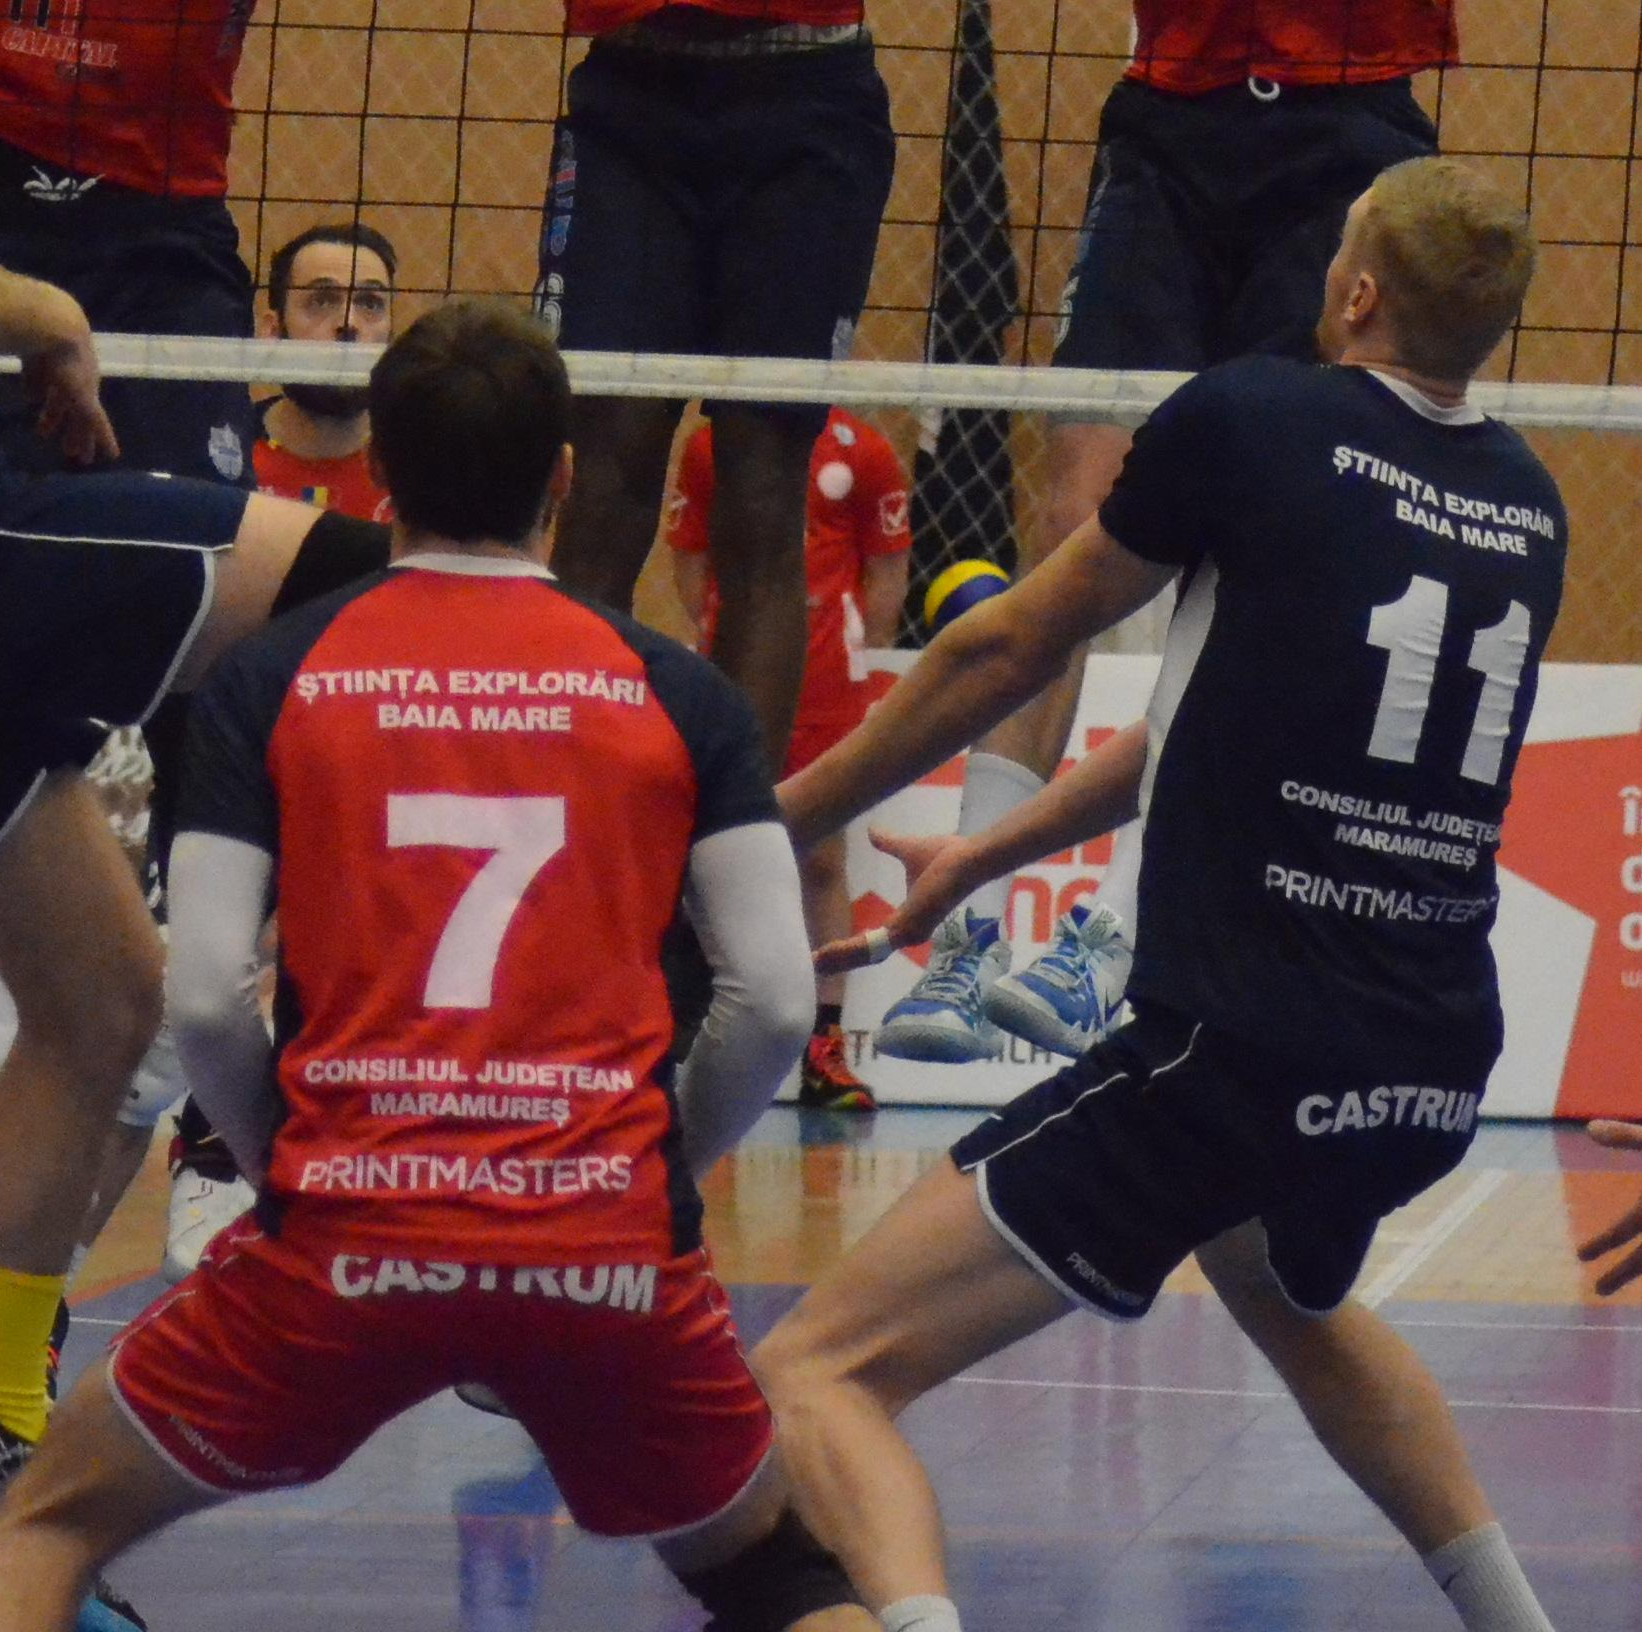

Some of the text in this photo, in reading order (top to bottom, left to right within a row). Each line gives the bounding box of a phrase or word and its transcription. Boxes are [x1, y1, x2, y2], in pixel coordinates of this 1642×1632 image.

[1331, 445, 1440, 507] ȘTIINȚA
[1395, 498, 1529, 557] BAIA MARE
[296, 667, 646, 706] ȘTIINȚA EXPLORĂRI
[1365, 573, 1532, 787] 11
[377, 704, 572, 733] BAIA MARE
[1280, 780, 1413, 827] CONSILIUL
[1333, 822, 1478, 872] MARAMUREȘ
[386, 793, 566, 1010] 7
[1265, 864, 1499, 923] PRINTMASTER
[304, 1058, 635, 1094] CONSILIUL JUDEȚEAN
[370, 1092, 571, 1129] MARAMUREȘ
[298, 1153, 635, 1195] PRINTMASTERS
[330, 1253, 658, 1314] CASTRUM
